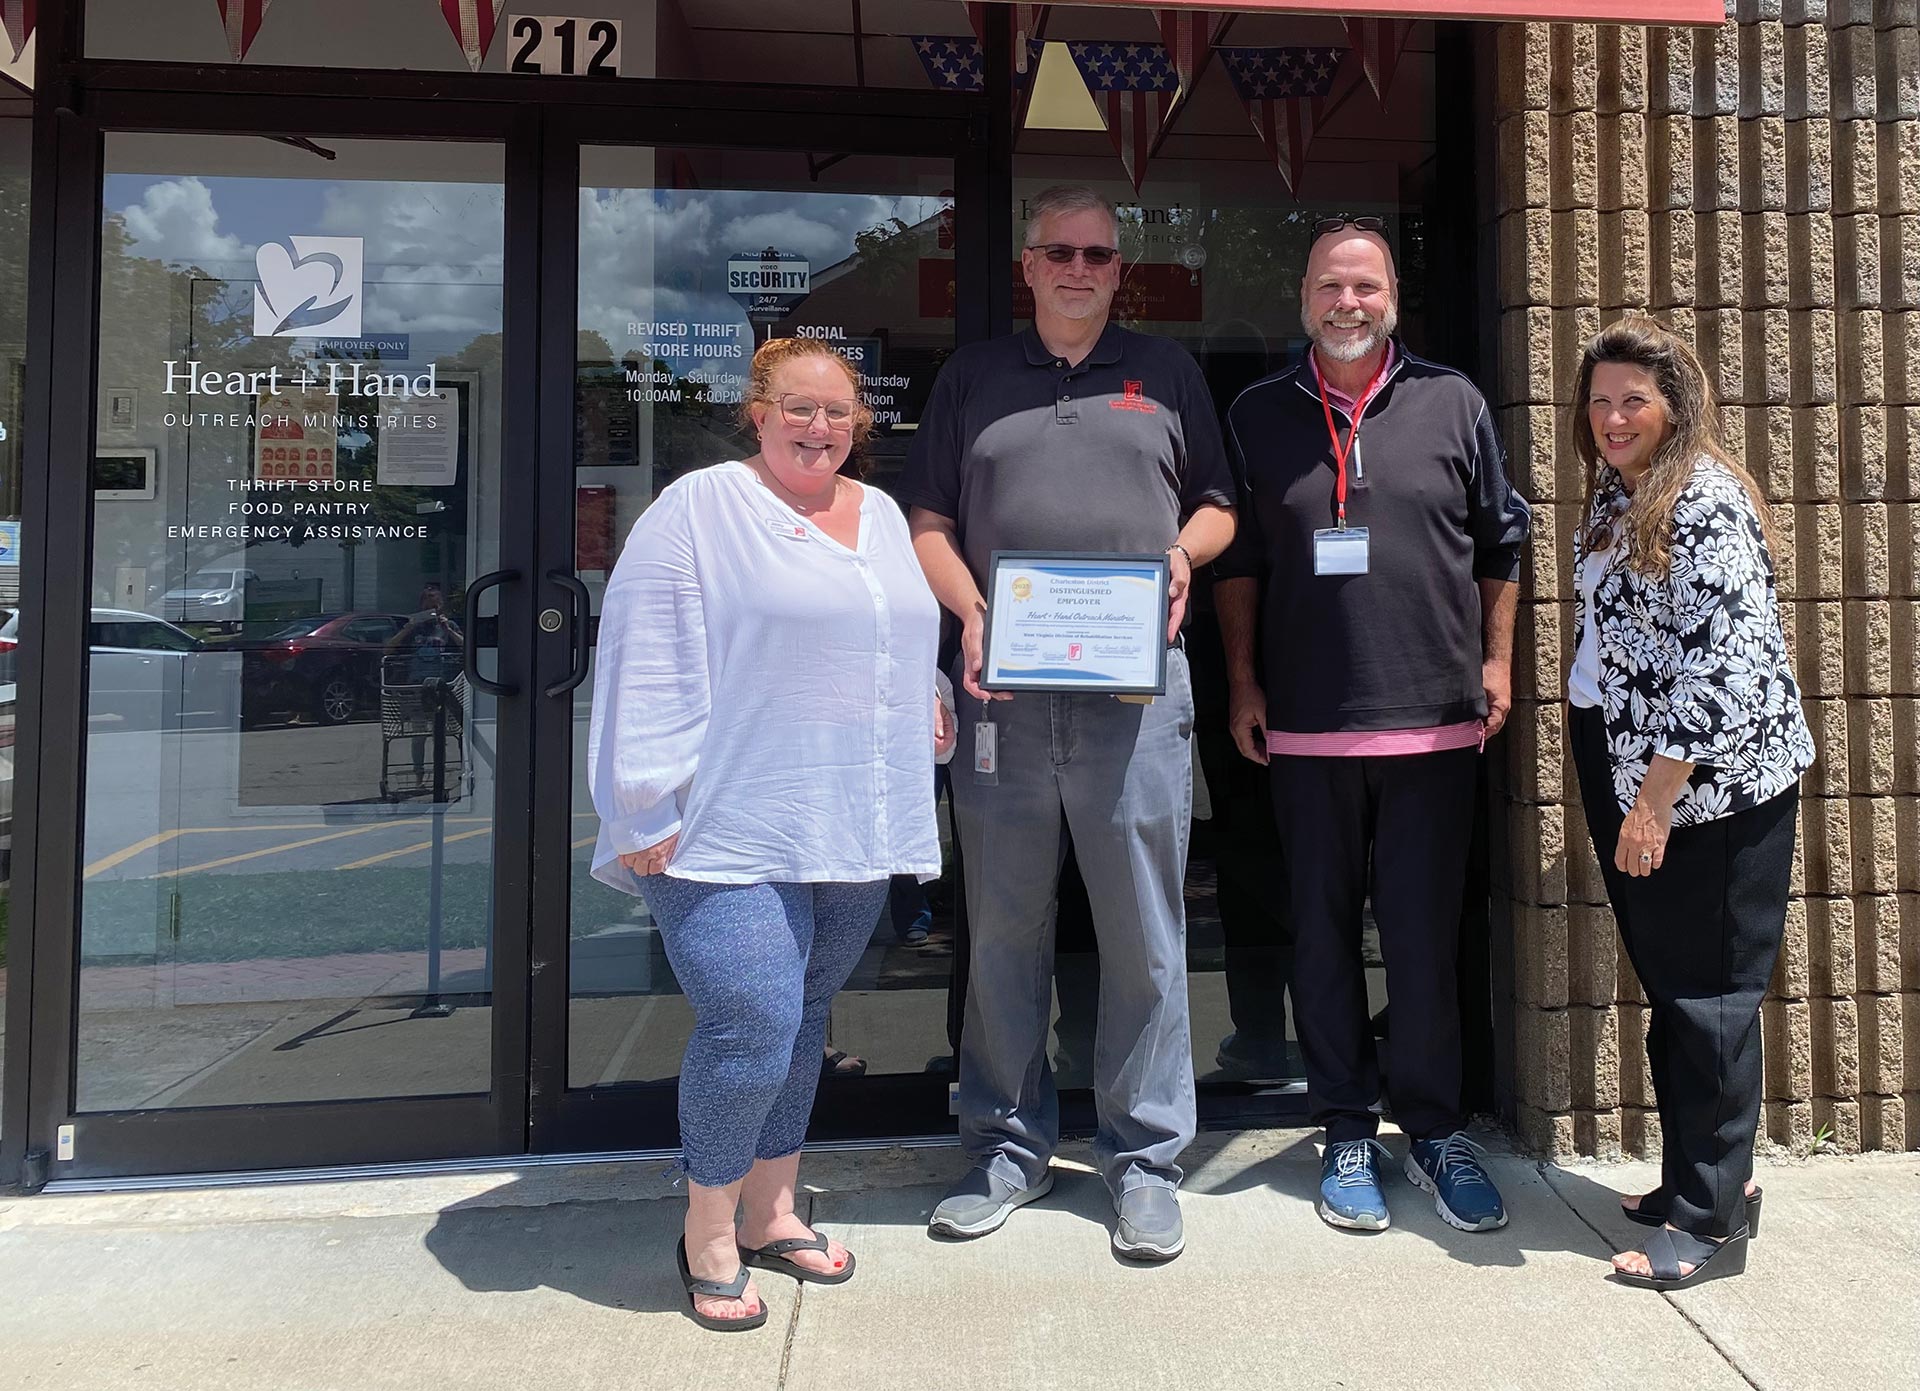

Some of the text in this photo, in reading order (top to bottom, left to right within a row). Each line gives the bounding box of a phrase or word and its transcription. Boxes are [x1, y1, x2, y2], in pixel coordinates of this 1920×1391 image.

[511, 17, 618, 77] 212
[730, 271, 807, 288] SECURITY
[759, 296, 778, 304] 24/7
[627, 323, 742, 337] REVISED THRIFT
[796, 325, 847, 340] SOCIAL
[318, 340, 406, 351] EMPLOYEES ONLY
[642, 343, 742, 358] STORE HOURS
[161, 360, 439, 397] Heart + Hand
[626, 370, 674, 386] Monday
[688, 371, 742, 387] Saturday
[856, 373, 910, 389] Thursday
[625, 389, 681, 402] 10:00AM
[695, 390, 742, 403] 4:00PM
[863, 393, 894, 405] Noon
[163, 413, 437, 429] OUTREACH MINISTRIES
[227, 480, 373, 492] THRIFT STORE
[229, 503, 370, 515] FOOD PANTRY
[168, 526, 428, 538] EMERGENCY ASSISTANCE
[1050, 587, 1112, 595] DISTINGUISHED
[1057, 597, 1101, 605] EMPLOYER
[1027, 611, 1048, 619] Heart
[1053, 612, 1074, 620] Hand
[1073, 612, 1102, 621] Outreach
[1102, 612, 1135, 622] Ministries
